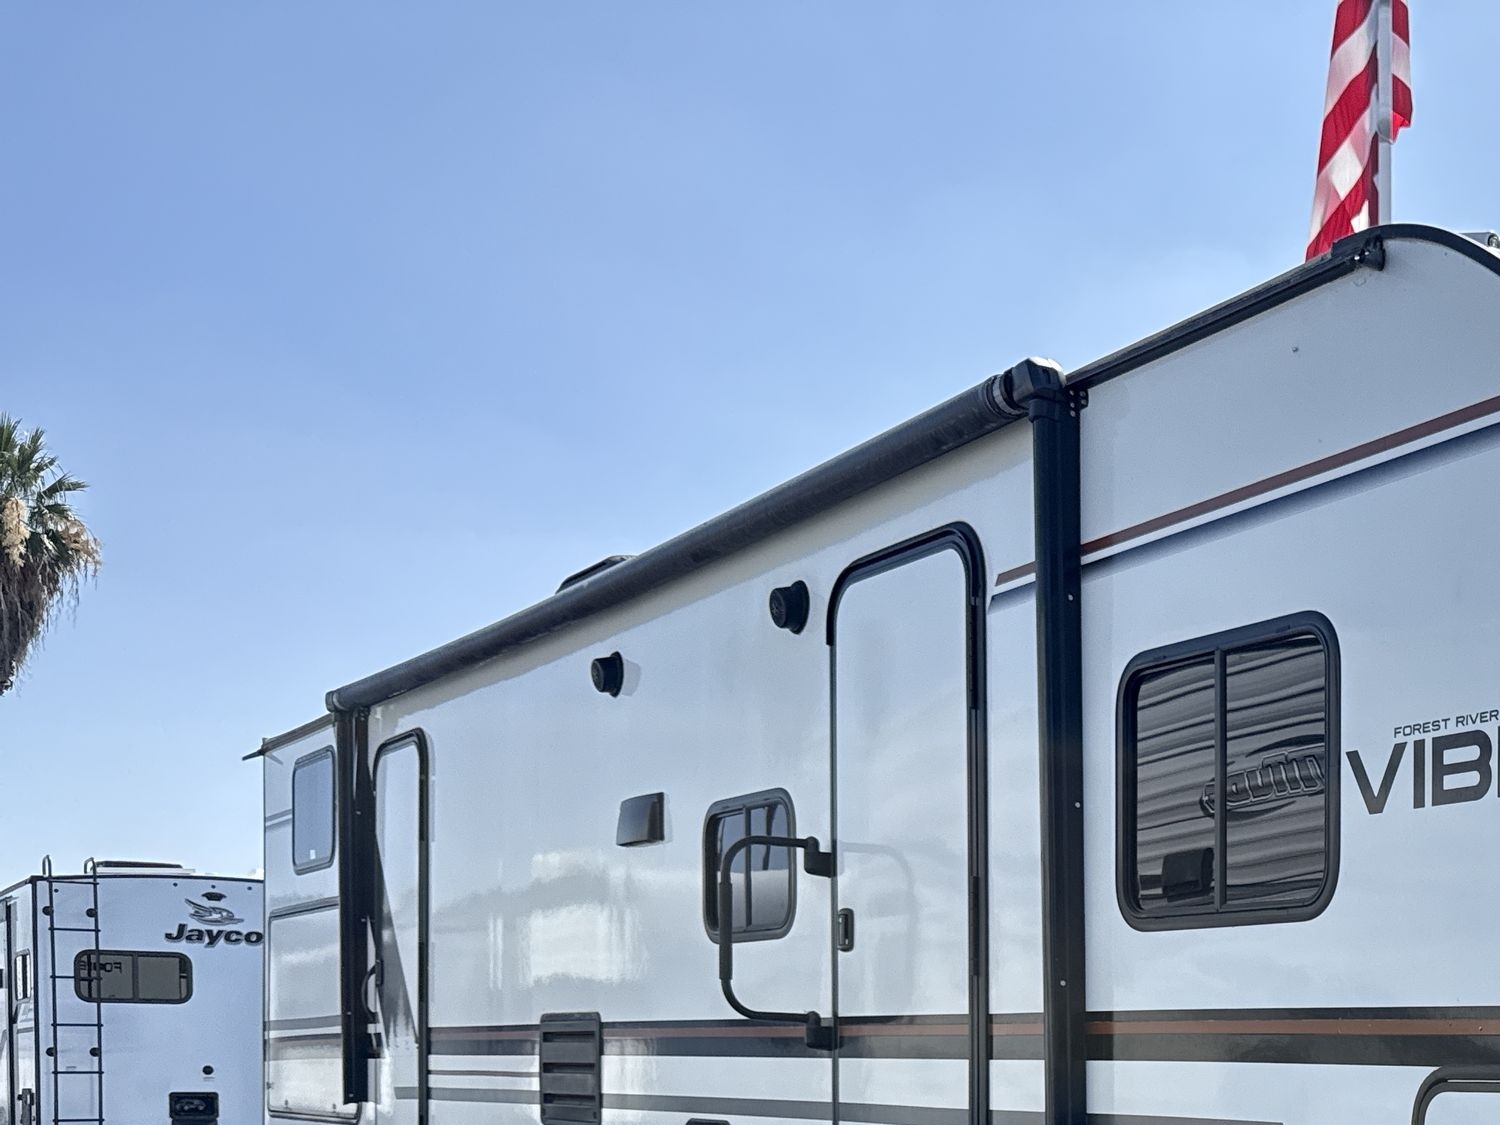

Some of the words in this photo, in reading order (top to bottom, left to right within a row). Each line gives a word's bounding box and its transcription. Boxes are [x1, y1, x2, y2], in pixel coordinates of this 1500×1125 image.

[1393, 717, 1451, 738] FOREST
[1455, 709, 1500, 727] RIVER
[164, 923, 264, 948] Jayco
